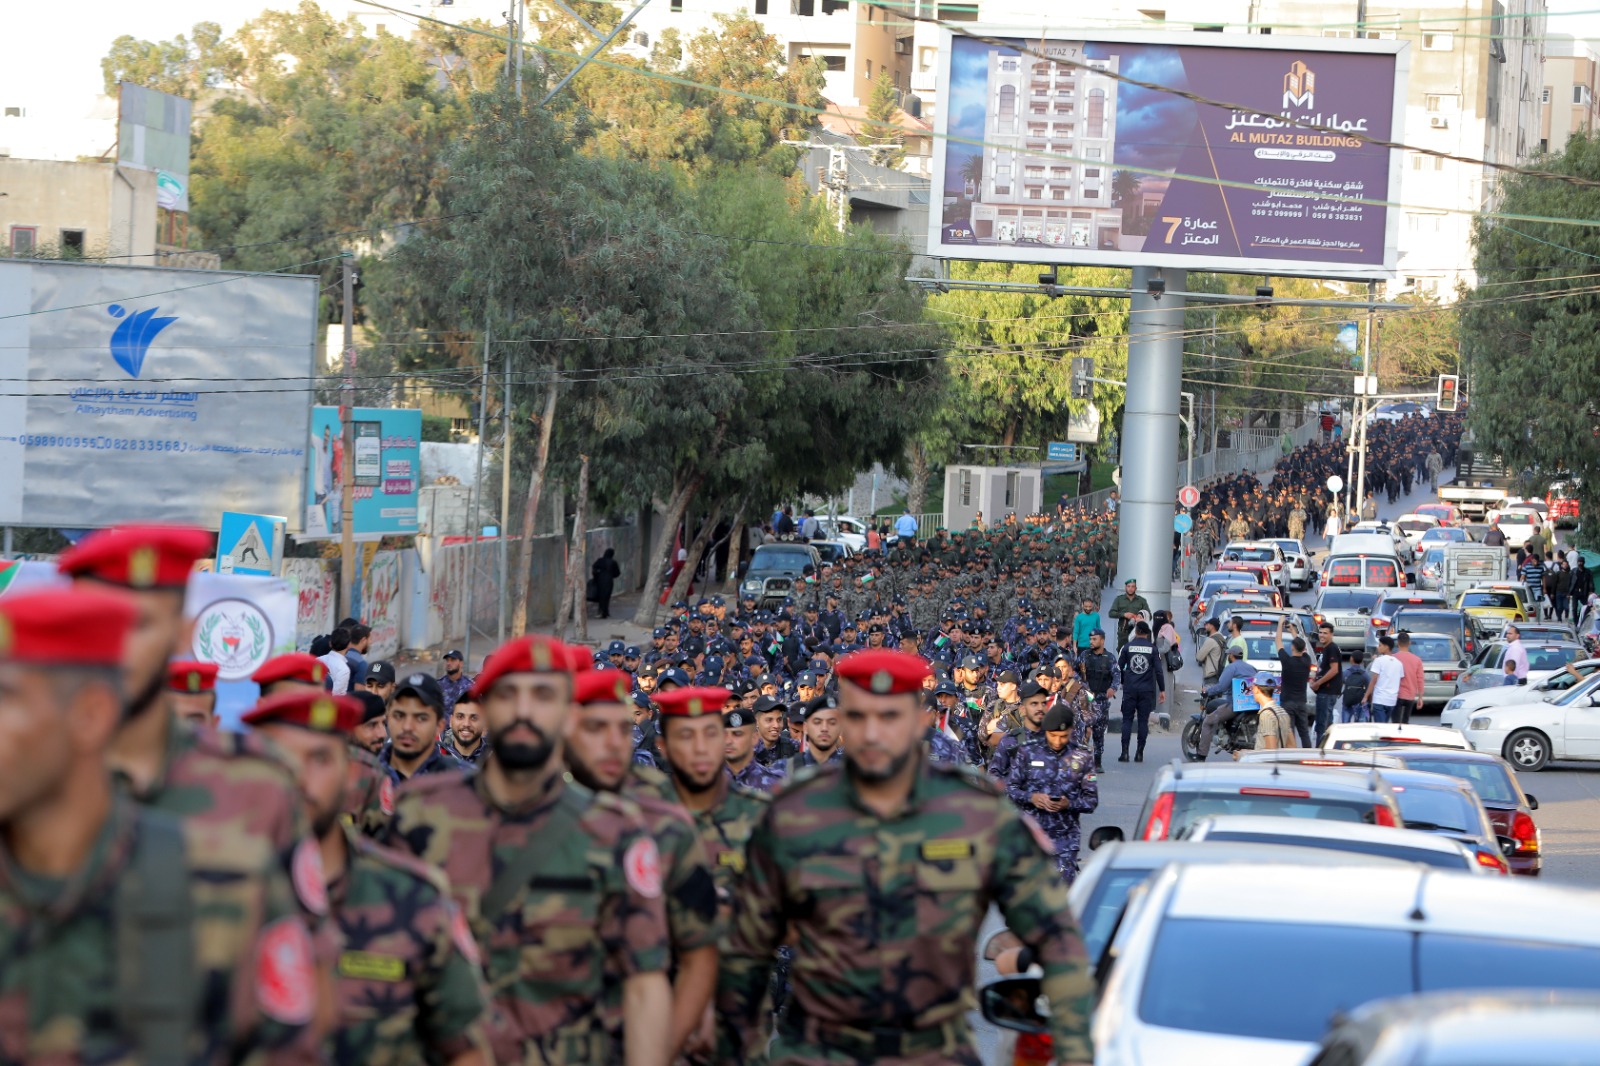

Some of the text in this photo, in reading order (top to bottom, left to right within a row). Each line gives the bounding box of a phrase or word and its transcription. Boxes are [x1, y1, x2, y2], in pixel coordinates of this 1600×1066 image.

[1071, 48, 1077, 58] 7
[1225, 108, 1368, 133] عمارات المعتز
[1230, 132, 1362, 148] AL MUTAZ BUILDINGS
[1254, 177, 1364, 190] شقق سكنية فاخرة للتمليك
[1252, 208, 1266, 216] 059
[1281, 202, 1302, 210] محمد
[1343, 204, 1362, 213] ماهر
[1312, 212, 1325, 220] 059
[1184, 216, 1217, 230] عمارة
[1162, 216, 1182, 244] 7
[1181, 233, 1219, 245] المعتز
[137, 406, 198, 422] Advertising
